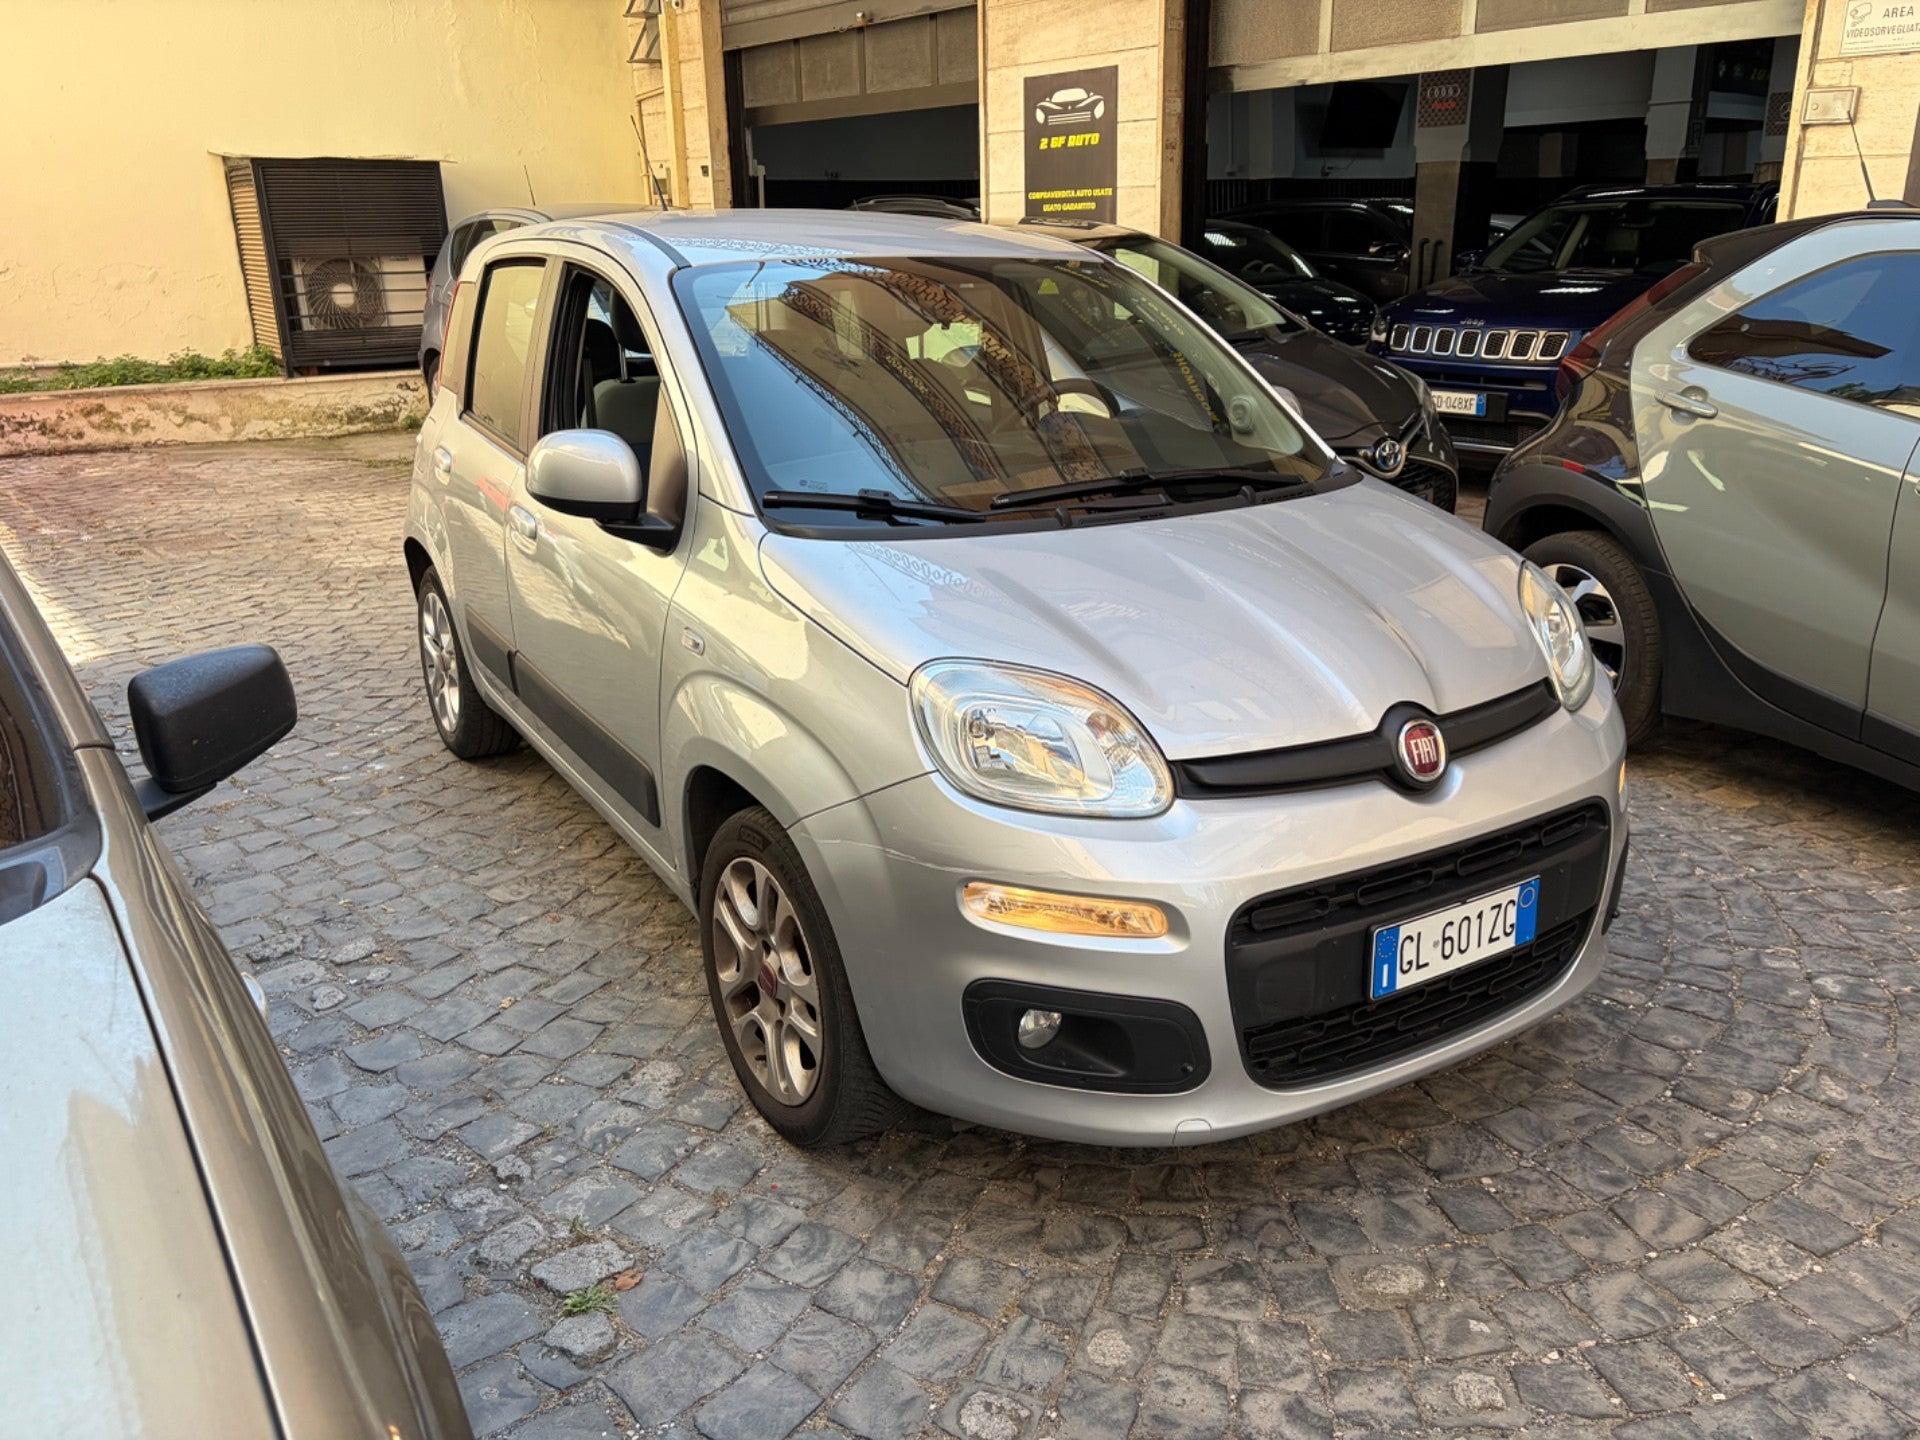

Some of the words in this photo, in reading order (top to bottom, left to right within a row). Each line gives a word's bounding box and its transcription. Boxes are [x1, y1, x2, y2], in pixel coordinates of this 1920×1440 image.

[1882, 5, 1915, 19] AREA
[1846, 22, 1920, 38] VIDEOSORVEGLIAT
[1039, 137, 1048, 150] 2
[1068, 133, 1100, 147] AUTO
[1076, 188, 1092, 197] AUTO
[1409, 735, 1438, 766] FIAT
[1399, 931, 1430, 975] GL
[1441, 898, 1517, 961] 601ZG
